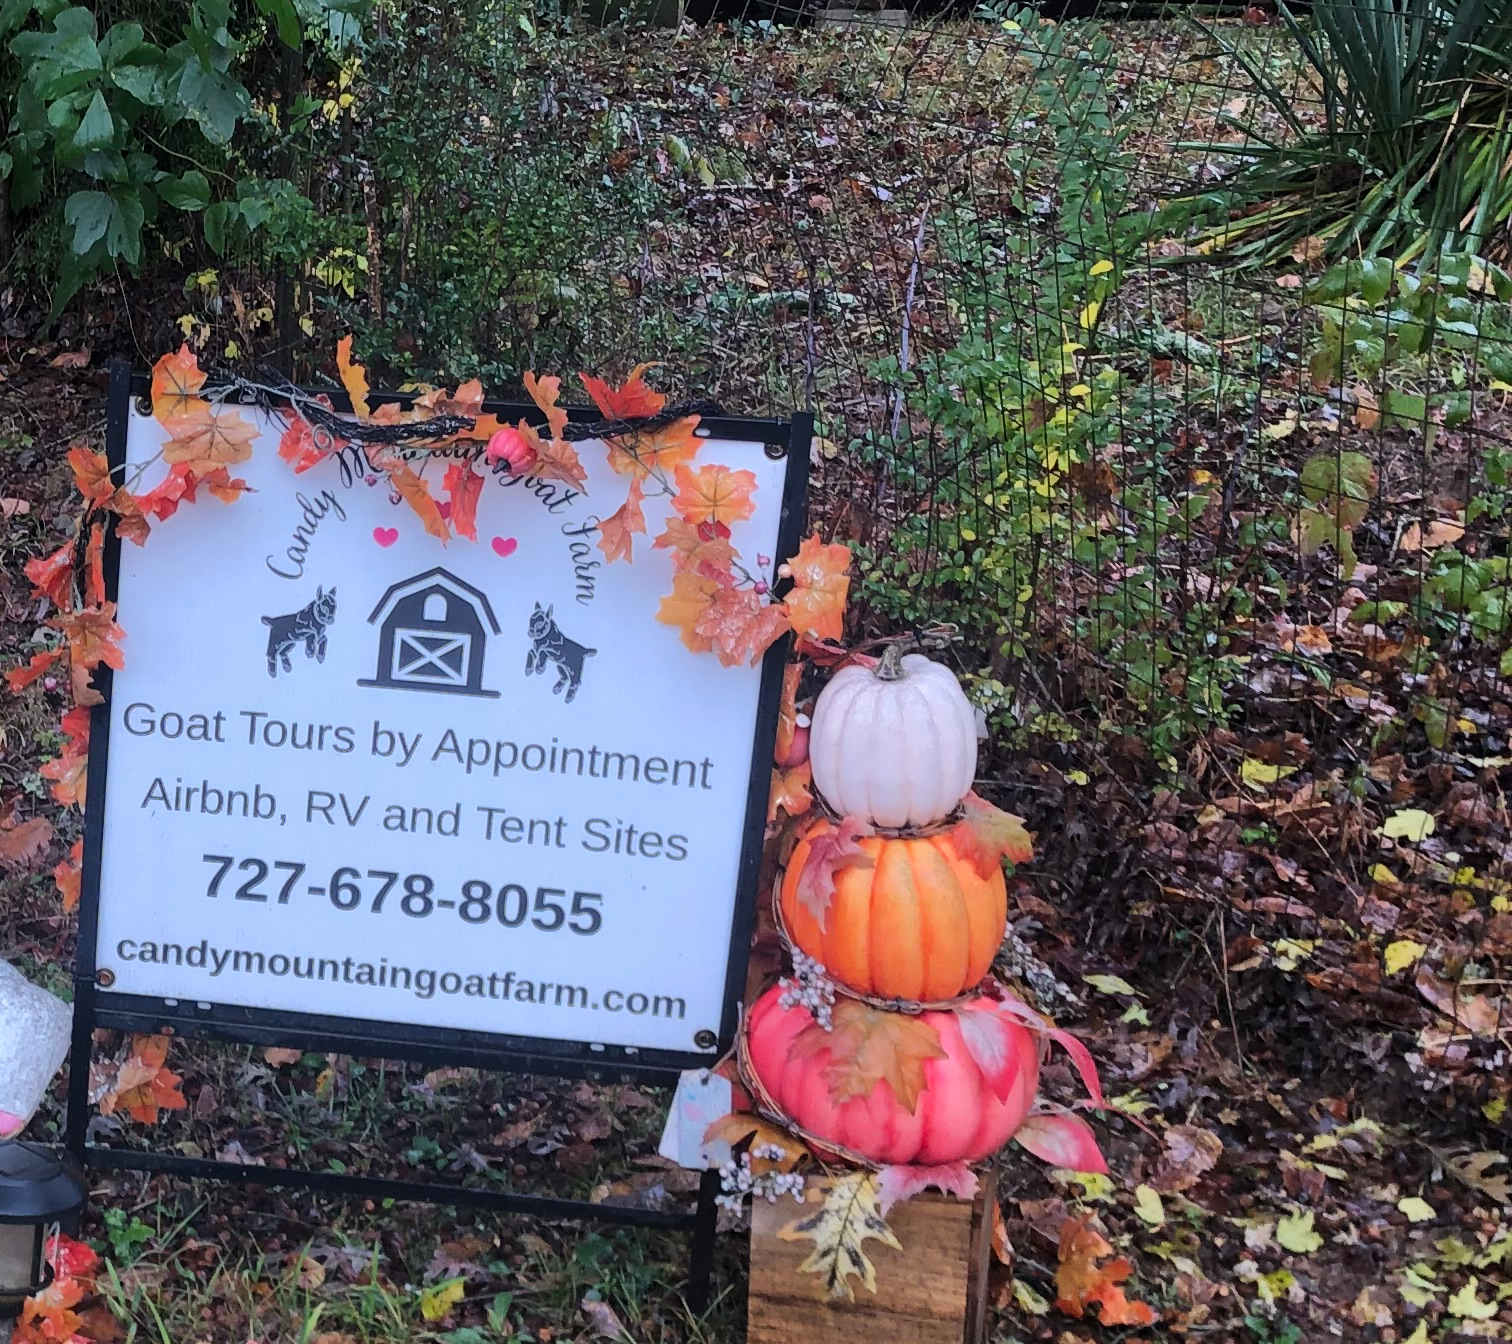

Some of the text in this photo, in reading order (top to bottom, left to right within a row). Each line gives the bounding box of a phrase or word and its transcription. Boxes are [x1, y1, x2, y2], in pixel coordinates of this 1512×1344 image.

[265, 489, 348, 580] Candy
[561, 514, 602, 607] Farm
[122, 701, 715, 791] Goat Tours by Appointment
[139, 776, 690, 862] Airbnb, RV and Tent Sites
[202, 853, 605, 937] 727-678-8055
[116, 938, 688, 1020] candymountaingoatfarm.com
